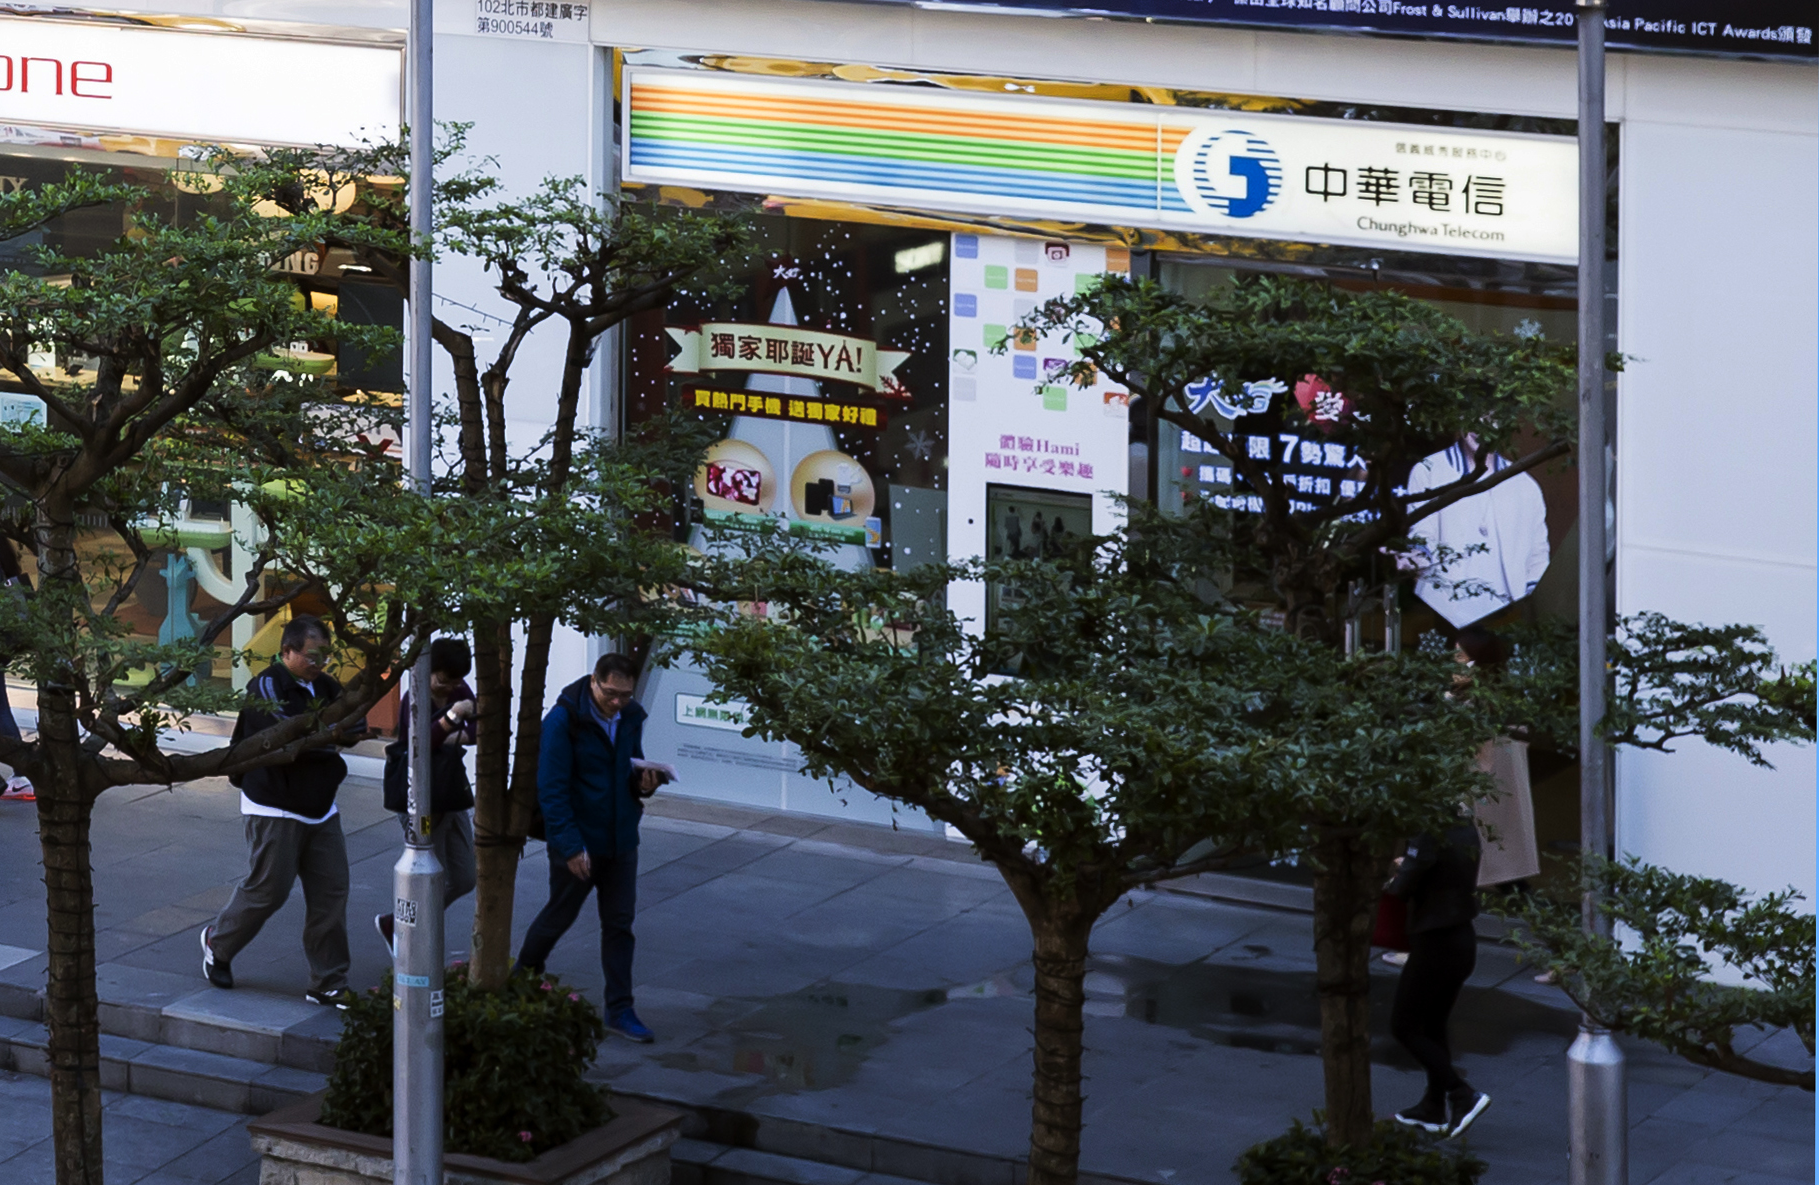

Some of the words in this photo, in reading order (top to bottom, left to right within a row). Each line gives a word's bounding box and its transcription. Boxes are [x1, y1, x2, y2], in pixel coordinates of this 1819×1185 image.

[476, 15, 554, 40] 第900544號
[1431, 3, 1444, 18] &
[1634, 17, 1687, 35] Pacific
[1691, 22, 1718, 37] ICT
[1305, 162, 1506, 216] 中華電信
[1356, 216, 1438, 237] Chunghwa
[1442, 223, 1505, 241] Telecom
[694, 389, 781, 416] 買熱門手機
[788, 399, 877, 427] 送獨家好禮
[984, 451, 1094, 480] 隨時享受樂趣
